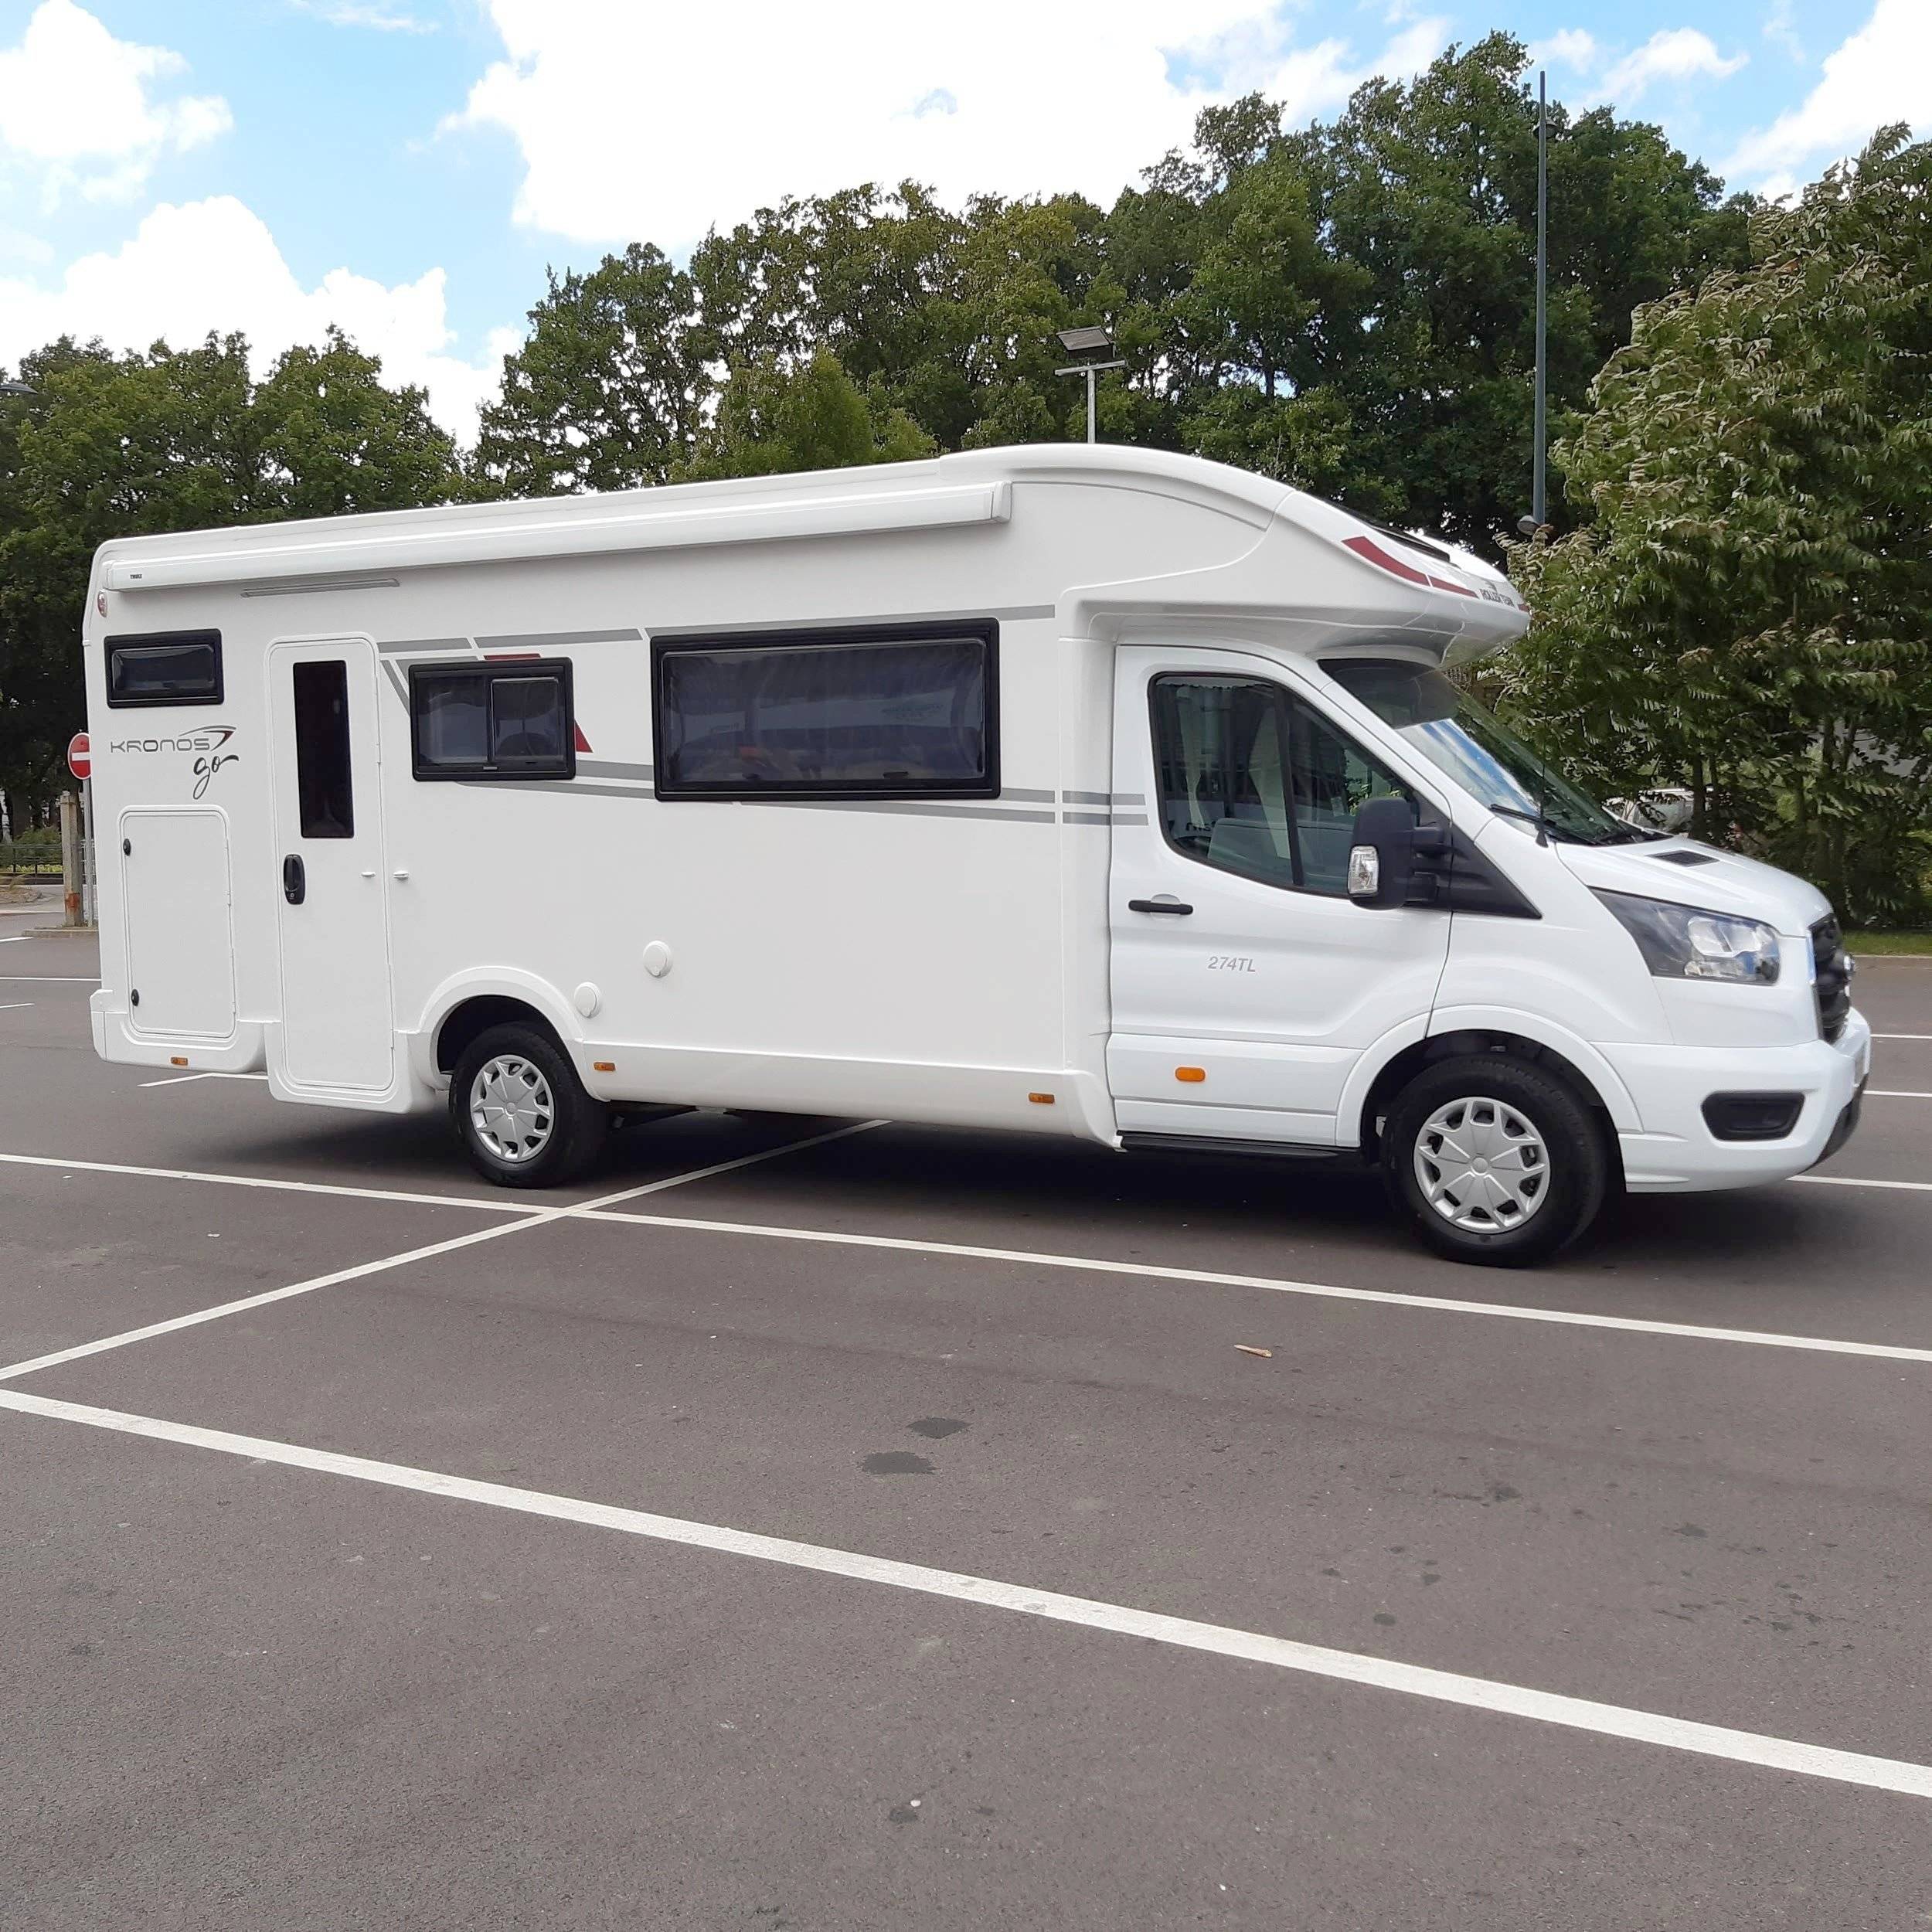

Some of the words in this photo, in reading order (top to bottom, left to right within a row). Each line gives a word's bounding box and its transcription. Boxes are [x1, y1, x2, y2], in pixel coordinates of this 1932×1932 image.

[111, 738, 210, 753] KRONOS
[192, 754, 240, 800] go
[1207, 956, 1256, 973] 274TL
